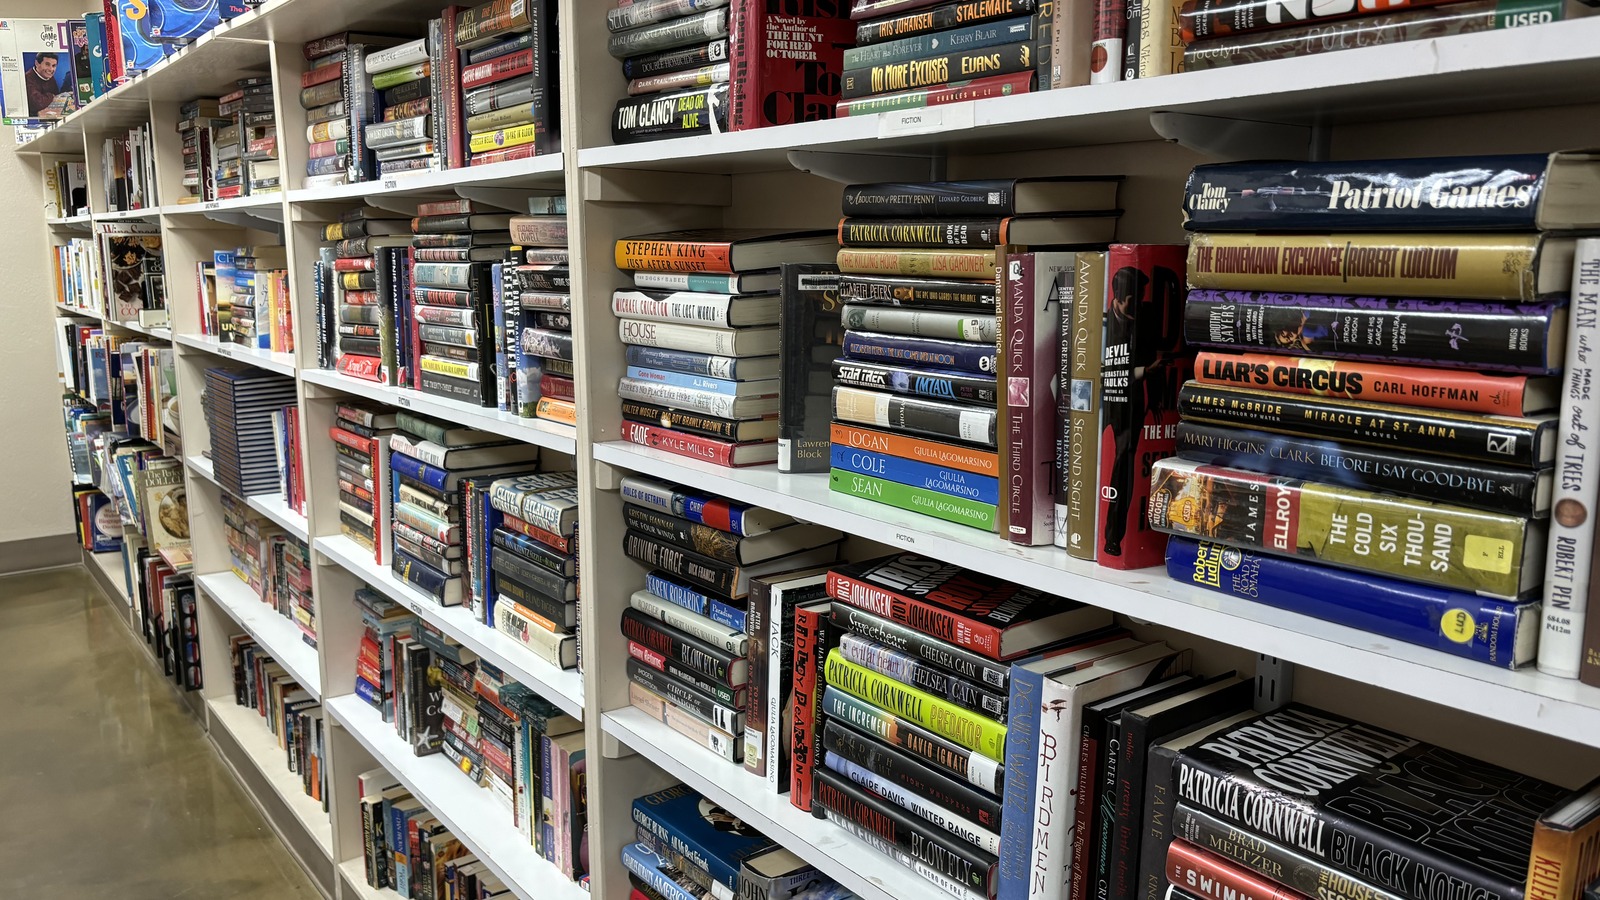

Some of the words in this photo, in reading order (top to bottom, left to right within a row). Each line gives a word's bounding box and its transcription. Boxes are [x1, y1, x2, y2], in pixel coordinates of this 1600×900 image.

[229, 5, 244, 13] The
[774, 16, 795, 24] Novel
[1504, 10, 1553, 29] USED
[766, 31, 794, 40] THE
[795, 32, 823, 43] HUNT
[780, 24, 806, 32] Author
[879, 18, 894, 37] IRIS
[895, 13, 932, 34] JOHANSEN
[766, 41, 787, 50] FOR
[788, 42, 812, 51] RED
[766, 51, 817, 60] OCTOBER
[618, 105, 637, 129] TOM
[639, 99, 676, 127] CLANCY
[678, 97, 694, 112] DEAD
[695, 95, 704, 108] OR
[682, 113, 699, 128] ALIVE
[902, 116, 922, 124] FICTION
[1201, 183, 1227, 198] Tom
[1189, 194, 1231, 213] Clancy
[518, 233, 539, 242] LOWELL
[850, 224, 889, 242] PATRICIA
[891, 225, 943, 243] CORNWELL
[626, 242, 672, 256] STEPHEN
[676, 243, 706, 258] KING
[627, 259, 644, 269] JUST
[648, 260, 672, 270] AFTER
[674, 260, 706, 271] SUNSET
[503, 259, 514, 316] JEFFERY
[1078, 260, 1090, 325] AMANDA
[512, 291, 520, 316] BANKS
[616, 298, 638, 314] MICHAEL
[671, 303, 681, 317] THE
[682, 304, 695, 319] LOST
[697, 305, 716, 321] WORLD
[623, 321, 656, 339] HOUSE
[995, 316, 1003, 354] Beatrice
[1222, 304, 1235, 343] SAYERS
[1375, 317, 1383, 346] CARCASE
[506, 320, 516, 369] DEAVER
[1010, 329, 1025, 372] QUICK
[1074, 328, 1088, 371] QUICK
[1509, 328, 1518, 350] WINGS
[1519, 328, 1529, 350] BOOKS
[1114, 356, 1129, 365] CARE
[693, 378, 702, 387] A.J.
[703, 379, 718, 389] Rivers
[1203, 359, 1268, 385] LIAR'S
[1273, 366, 1363, 394] CIRCUS
[1581, 368, 1592, 400] MADE
[1374, 381, 1406, 395] CARL
[1412, 384, 1479, 402] HOFFMAN
[1189, 395, 1225, 406] JAMES
[1232, 400, 1282, 415] McBRIDE
[1012, 413, 1023, 434] THE
[1144, 424, 1161, 440] THE
[1370, 418, 1385, 429] AT
[1393, 421, 1412, 433] ST.
[1418, 426, 1456, 439] ANNA
[629, 424, 650, 446] FADE
[662, 436, 685, 449] KYLE
[687, 443, 714, 458] MILLS
[797, 449, 822, 458] Block
[848, 431, 889, 451] LOGAN
[914, 446, 938, 458] GIULIA
[938, 452, 992, 469] LAGOMARSINO
[1072, 418, 1084, 476] SECOND
[851, 453, 886, 474] COLE
[1012, 439, 1023, 471] THIRD
[1184, 432, 1215, 448] MARY
[1218, 435, 1265, 455] HIGGINS
[1269, 447, 1315, 465] CLARK
[1320, 453, 1370, 474] BEFORE
[1382, 464, 1407, 479] SAY
[1411, 468, 1495, 493] GOOD-BYE
[497, 487, 516, 504] CLIVE
[851, 477, 883, 497] SEAN
[911, 495, 934, 509] GIULIA
[936, 500, 988, 522] LAGOMARSINO
[925, 477, 979, 497] LAGOMARSINO
[1012, 474, 1024, 513] CIRCLE
[1071, 478, 1083, 520] SIGHT
[525, 499, 556, 521] ATLANTIS
[896, 533, 915, 544] FICTION
[1330, 513, 1348, 545] THE
[1354, 512, 1373, 555] COLD
[1380, 523, 1398, 553] SIX
[628, 535, 657, 564] DRIVING
[659, 547, 684, 575] FORCE
[688, 562, 698, 574] DICK
[698, 565, 716, 583] FRANCIS
[1430, 523, 1452, 572] SAND
[837, 578, 850, 601] IRIS
[1232, 573, 1241, 592] THE
[850, 582, 891, 617] JOHANSEN
[907, 602, 955, 641] JOHANSEN
[770, 621, 779, 657] JACK
[820, 630, 825, 644] WE
[920, 643, 952, 666] CHELSEA
[955, 657, 976, 678] CAIN
[828, 659, 868, 698] PATRICIA
[871, 673, 924, 721] CORNWELL
[544, 739, 552, 772] marian
[1107, 738, 1121, 785] CARTER
[819, 780, 853, 818] PATRICIA
[853, 798, 896, 845] CORNWELL
[851, 772, 879, 794] CLAIRE
[881, 787, 905, 807] DAVIS
[911, 803, 945, 827] WINTER
[948, 822, 981, 846] RANGE
[1151, 784, 1166, 840] FAME
[1179, 763, 1241, 821] PATRICIA
[1243, 791, 1325, 857] CORNWELL
[1331, 828, 1410, 893] BLACK
[1227, 829, 1266, 855] BRAD
[911, 831, 944, 871] BLOW
[947, 851, 971, 886] FLY
[1209, 834, 1283, 878] MELTZER
